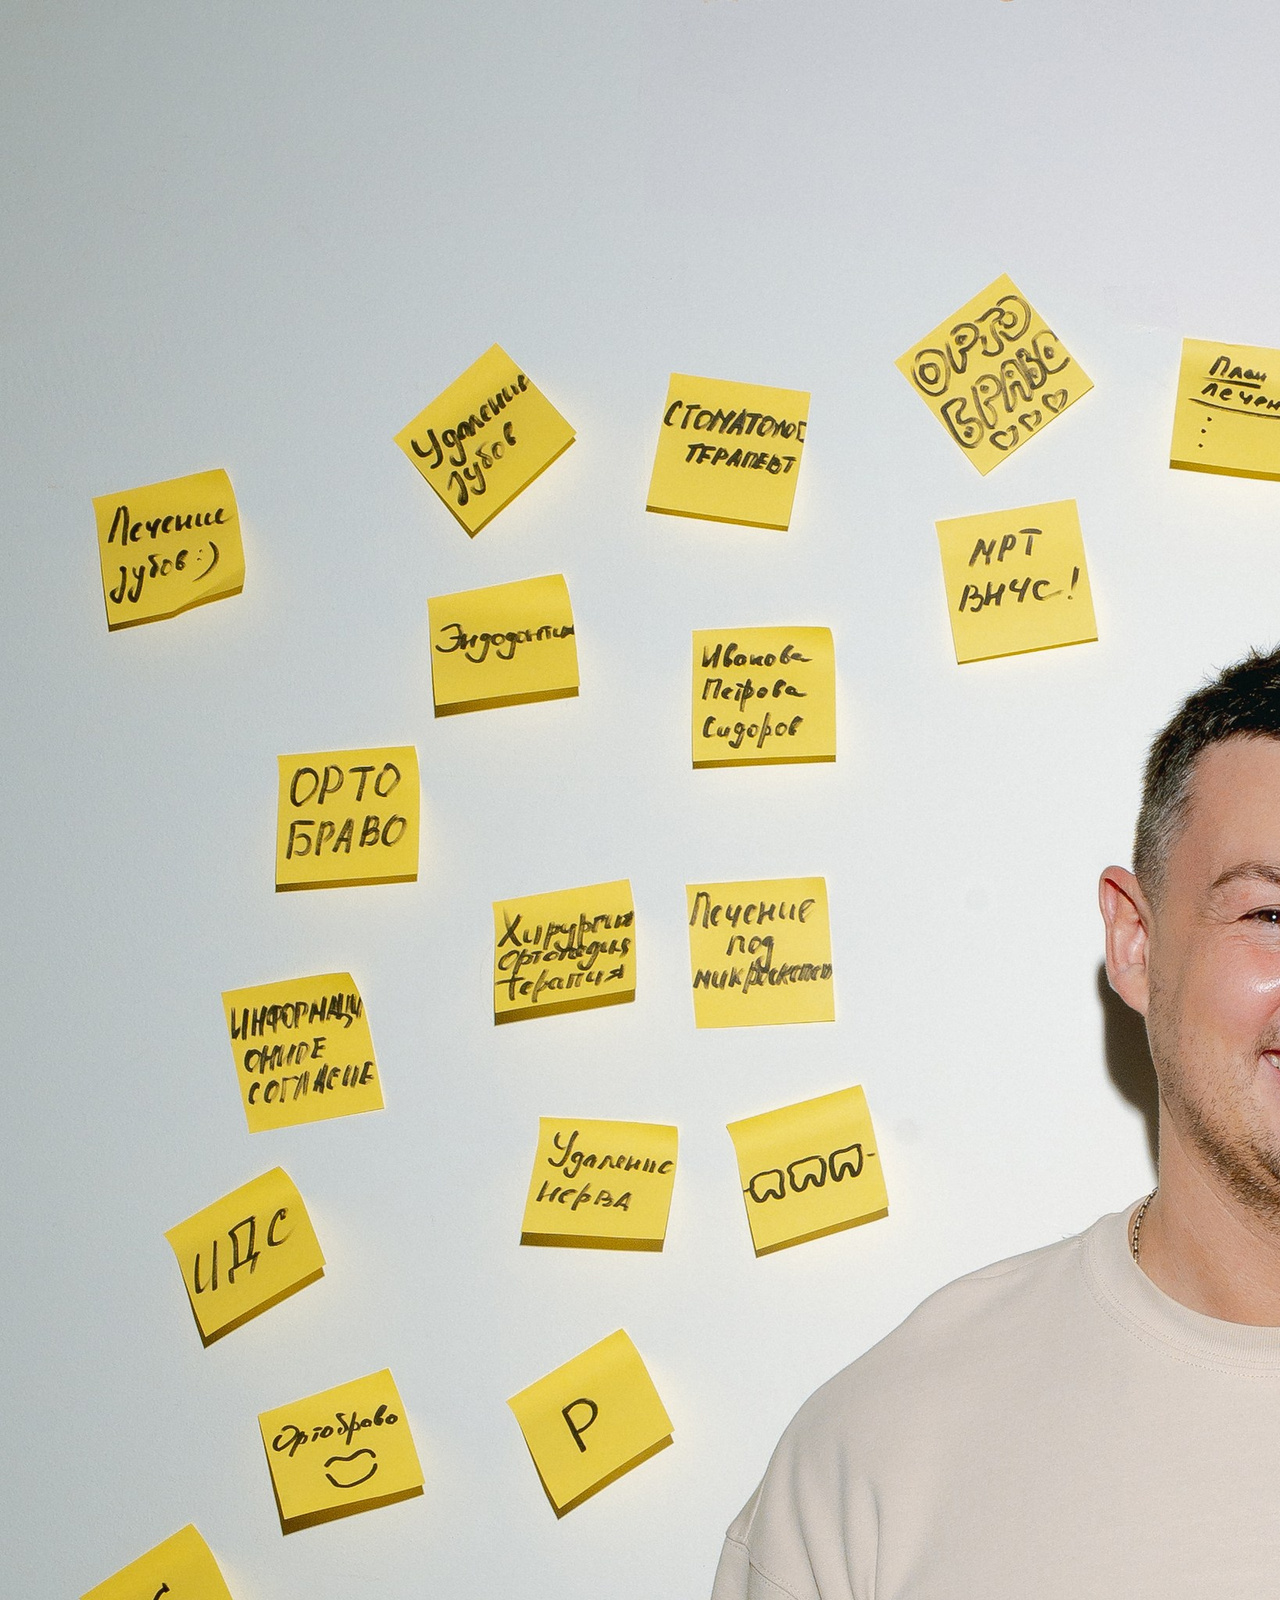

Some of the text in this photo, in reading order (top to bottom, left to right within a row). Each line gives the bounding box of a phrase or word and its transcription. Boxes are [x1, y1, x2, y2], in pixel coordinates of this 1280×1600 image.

[1208, 355, 1267, 382] План
[411, 374, 528, 469] Удаление
[447, 421, 517, 506] зубов
[685, 442, 797, 475] ТЕРАПЕВТ
[107, 505, 230, 544] Лечение
[968, 528, 1043, 567] МРТ
[702, 643, 812, 668] Иванова
[702, 678, 807, 712] Петрова
[702, 712, 804, 749] Сидоров
[289, 763, 400, 808] ОРТО
[287, 815, 407, 860] БРАВО
[689, 891, 815, 929] Лечение
[726, 935, 774, 973] под
[495, 964, 625, 1003] Терапия
[548, 1130, 673, 1178] Удаление
[194, 1208, 292, 1294] ИДС
[272, 1404, 398, 1457] Ортобраво
